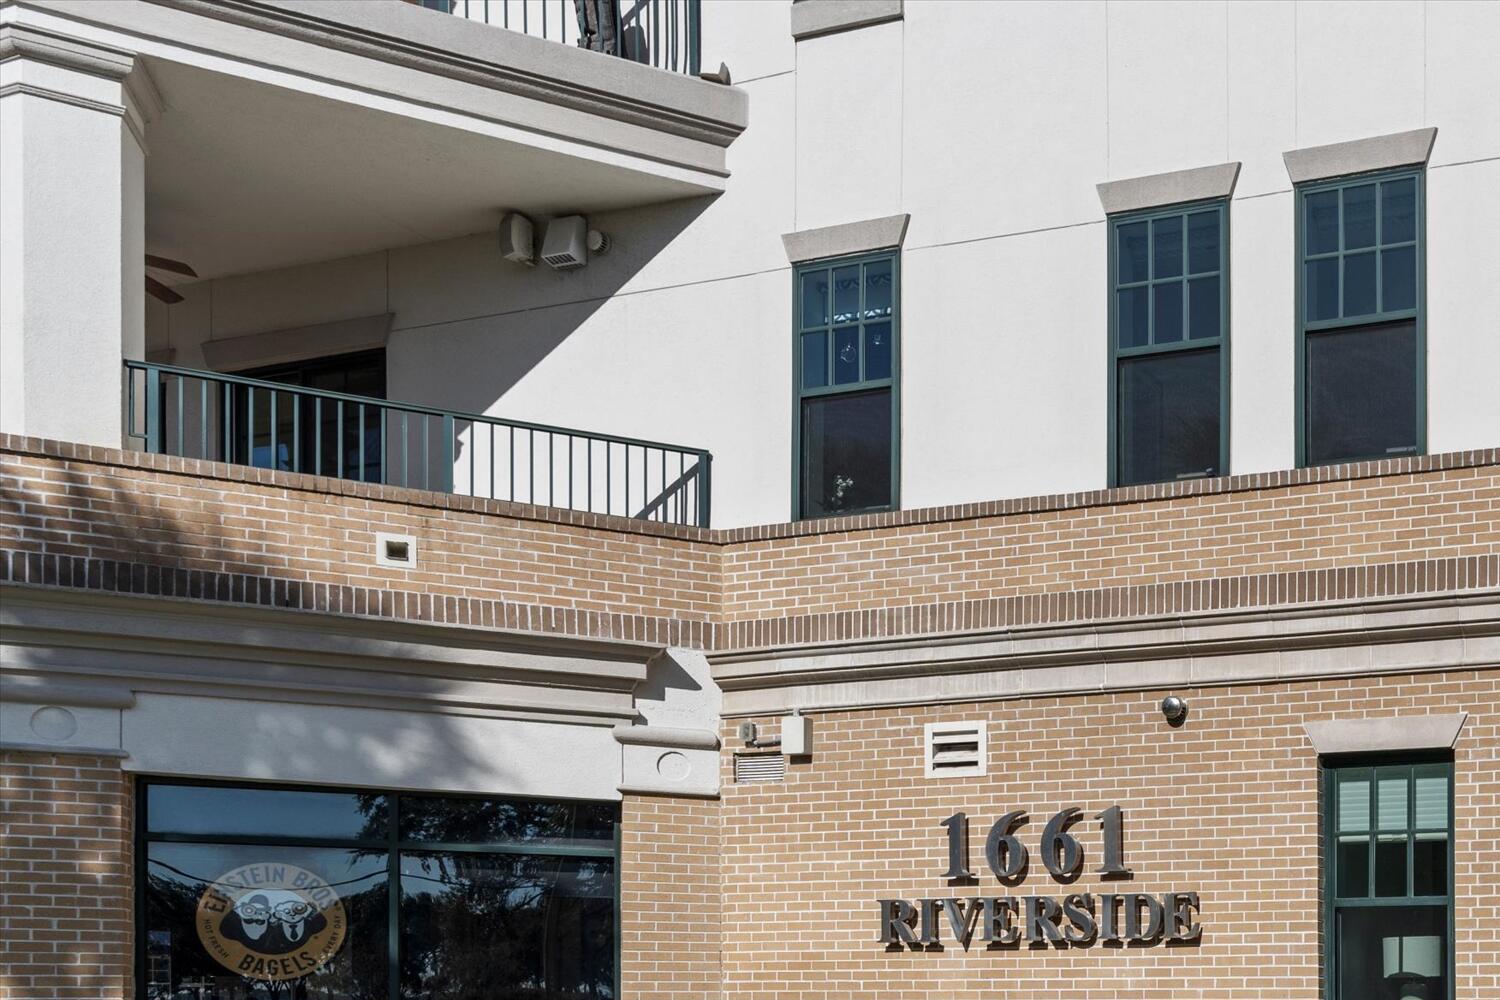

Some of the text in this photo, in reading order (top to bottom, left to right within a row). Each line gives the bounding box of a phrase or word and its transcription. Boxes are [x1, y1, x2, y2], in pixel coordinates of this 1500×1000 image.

[939, 805, 1131, 883] 1661
[203, 919, 230, 958] HOT FRESH
[322, 914, 342, 953] EVERY DAY
[877, 892, 1200, 947] RIVERSIDE
[238, 951, 317, 975] BAGELS
